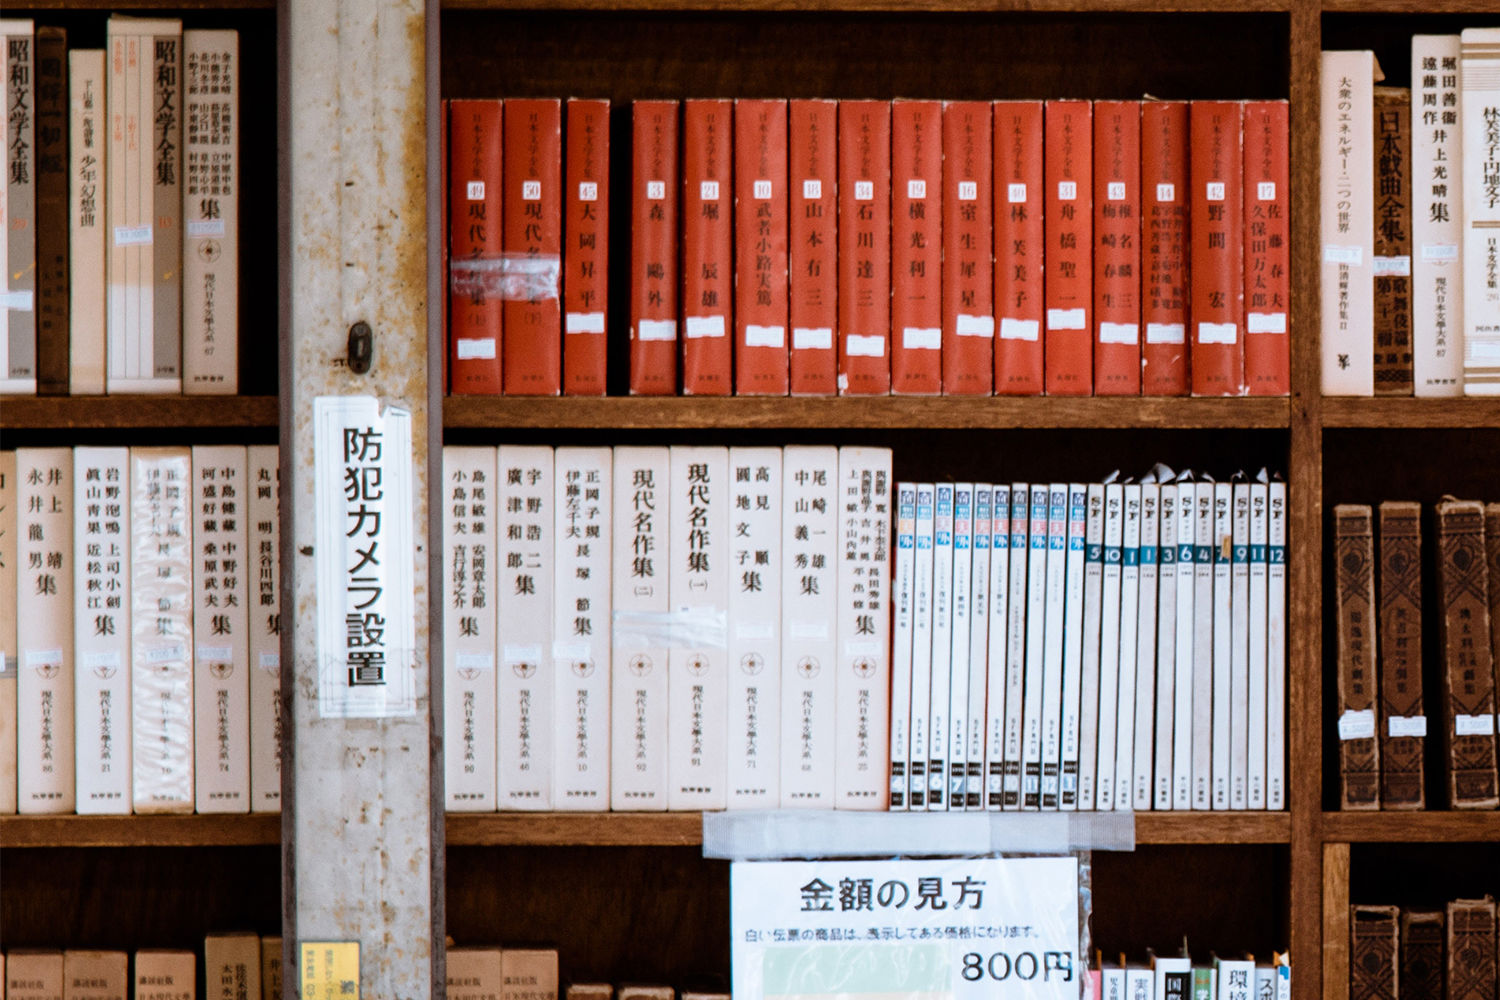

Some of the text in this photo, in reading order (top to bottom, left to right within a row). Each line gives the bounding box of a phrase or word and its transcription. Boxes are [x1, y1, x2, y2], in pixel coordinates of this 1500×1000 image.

[9, 40, 29, 185] 昭和文学全集
[155, 39, 177, 186] 昭和文学全集
[1423, 57, 1438, 125] 遠藤周作
[1430, 130, 1449, 223] 井上光晴 集
[1483, 107, 1500, 208] 林芙美子・円地文子
[200, 198, 220, 219] 集
[702, 204, 719, 308] 堀辰雄
[806, 203, 823, 307] 山本有三
[1208, 204, 1225, 309] 野間宏
[28, 467, 44, 570] 永井龍男
[48, 467, 62, 570] 井上靖
[453, 470, 467, 608] 小島信夫 吉行淳之介
[527, 468, 542, 569] 宇野浩二
[566, 470, 581, 539] 伊藤左千夫
[586, 470, 600, 539] 正岡子規
[632, 469, 655, 578] 現代名作集
[687, 464, 710, 573] 現代名作集
[755, 467, 769, 565] 高見順
[795, 470, 809, 569] 中山義秀
[812, 470, 827, 569] 尾崎一雄
[343, 427, 386, 687] 防犯カメラ設置
[472, 470, 486, 609] 島尾敏雄 安岡章太郎
[1091, 548, 1099, 559] 5
[1105, 550, 1120, 561] 10
[1164, 550, 1173, 561] 3
[1181, 547, 1192, 561] 6
[1237, 548, 1246, 560] 9
[1270, 550, 1284, 561] 12
[35, 574, 58, 596] 集
[515, 574, 535, 596] 集
[742, 572, 762, 592] 集
[801, 576, 820, 595] 集
[94, 614, 116, 636] 集
[211, 614, 232, 636] 集
[459, 616, 479, 637] 集
[574, 616, 592, 636] 集
[856, 615, 875, 636] 集
[800, 876, 986, 912] 金額の見方
[962, 951, 1073, 982] 800円
